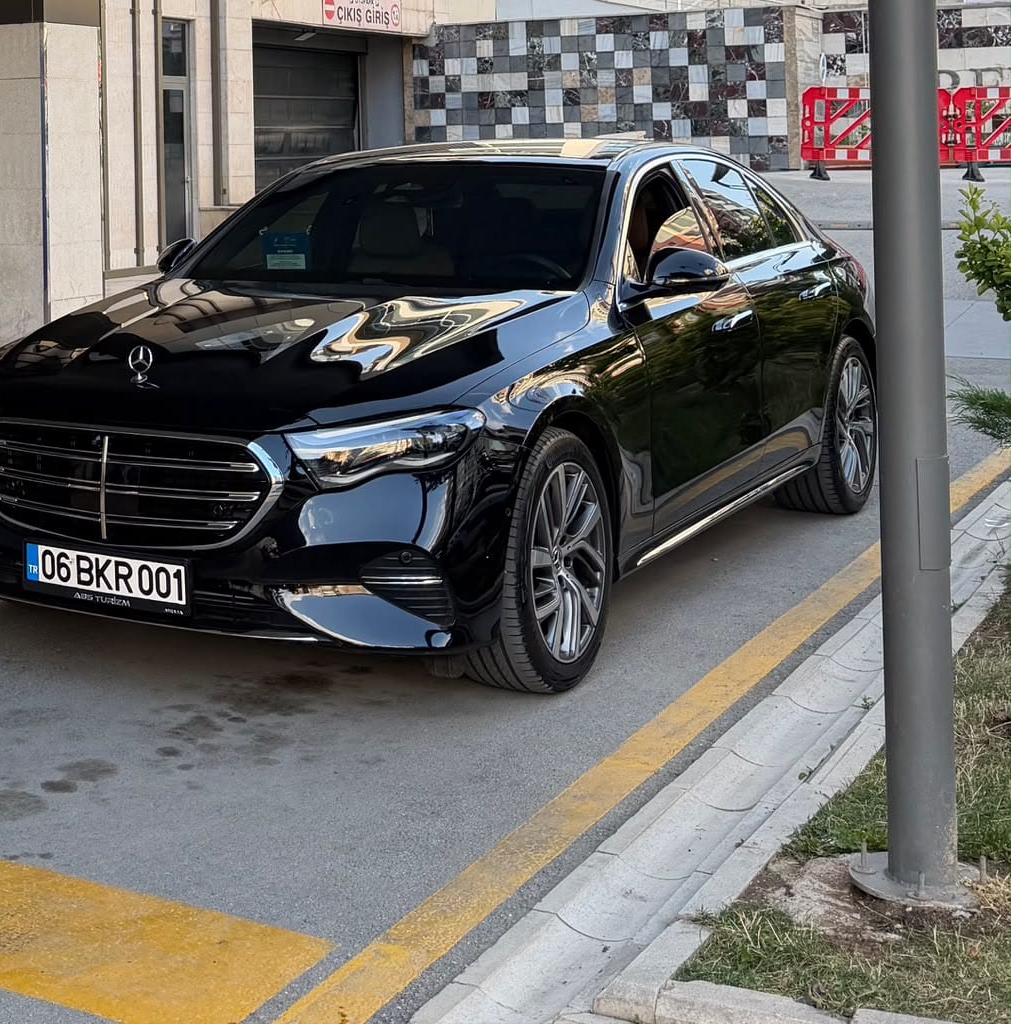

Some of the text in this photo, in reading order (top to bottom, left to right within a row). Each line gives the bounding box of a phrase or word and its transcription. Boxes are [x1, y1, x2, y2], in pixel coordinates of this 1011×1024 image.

[337, 6, 362, 27] ÇIKIŞ
[365, 6, 390, 29] GİRİŞ
[28, 564, 38, 575] TR
[41, 549, 183, 602] 06 BKR 001
